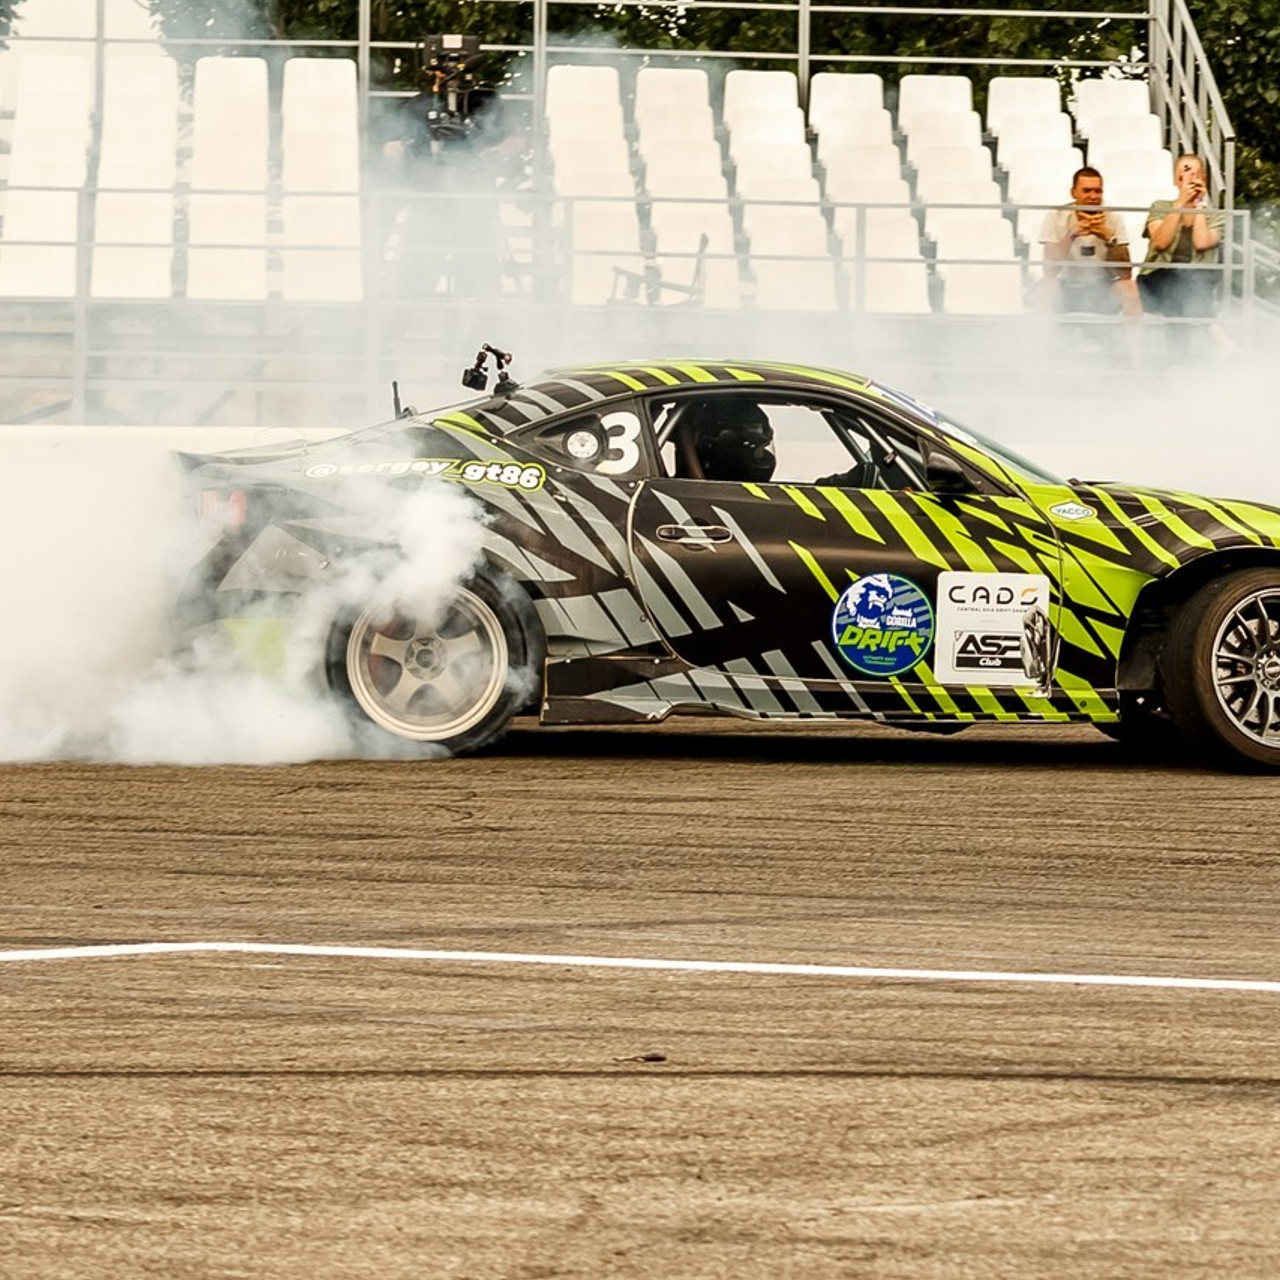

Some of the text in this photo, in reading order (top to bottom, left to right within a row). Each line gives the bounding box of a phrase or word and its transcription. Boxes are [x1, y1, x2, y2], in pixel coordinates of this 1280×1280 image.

[594, 411, 640, 475] 3
[948, 585, 1038, 606] CADS
[979, 657, 1001, 667] Club
